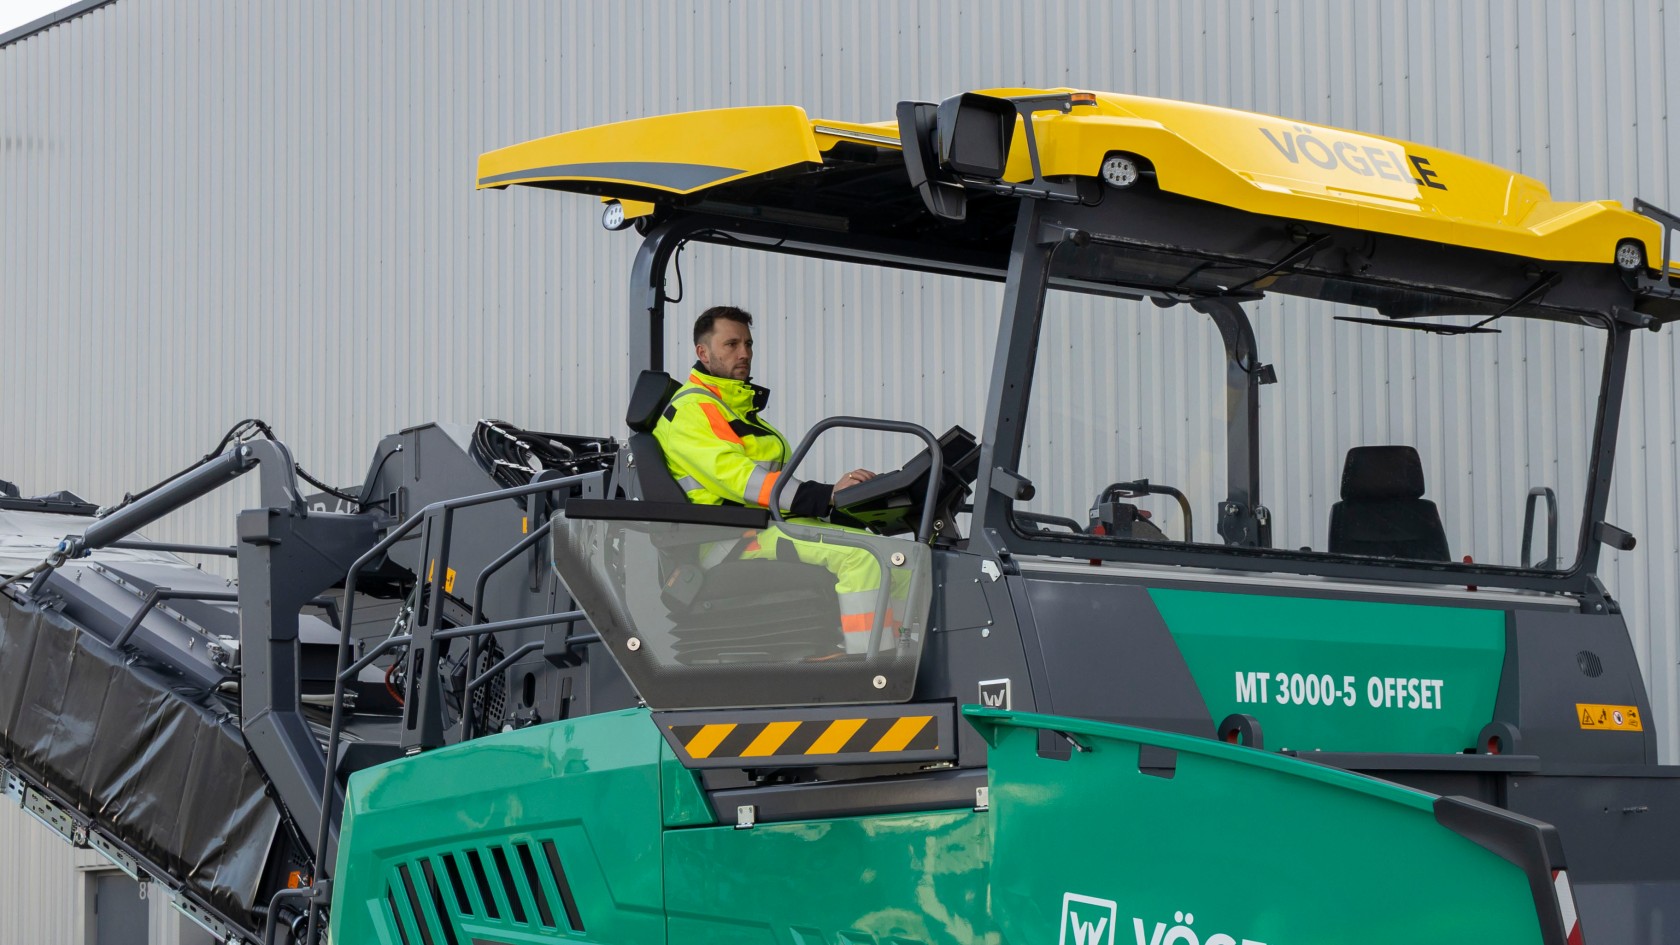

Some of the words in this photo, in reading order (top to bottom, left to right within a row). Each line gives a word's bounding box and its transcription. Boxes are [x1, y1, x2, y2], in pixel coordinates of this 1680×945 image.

[1258, 125, 1448, 191] VÖGELE
[1235, 671, 1270, 703] MT
[1275, 672, 1357, 707] 3000-5
[1367, 676, 1444, 709] OFFSET
